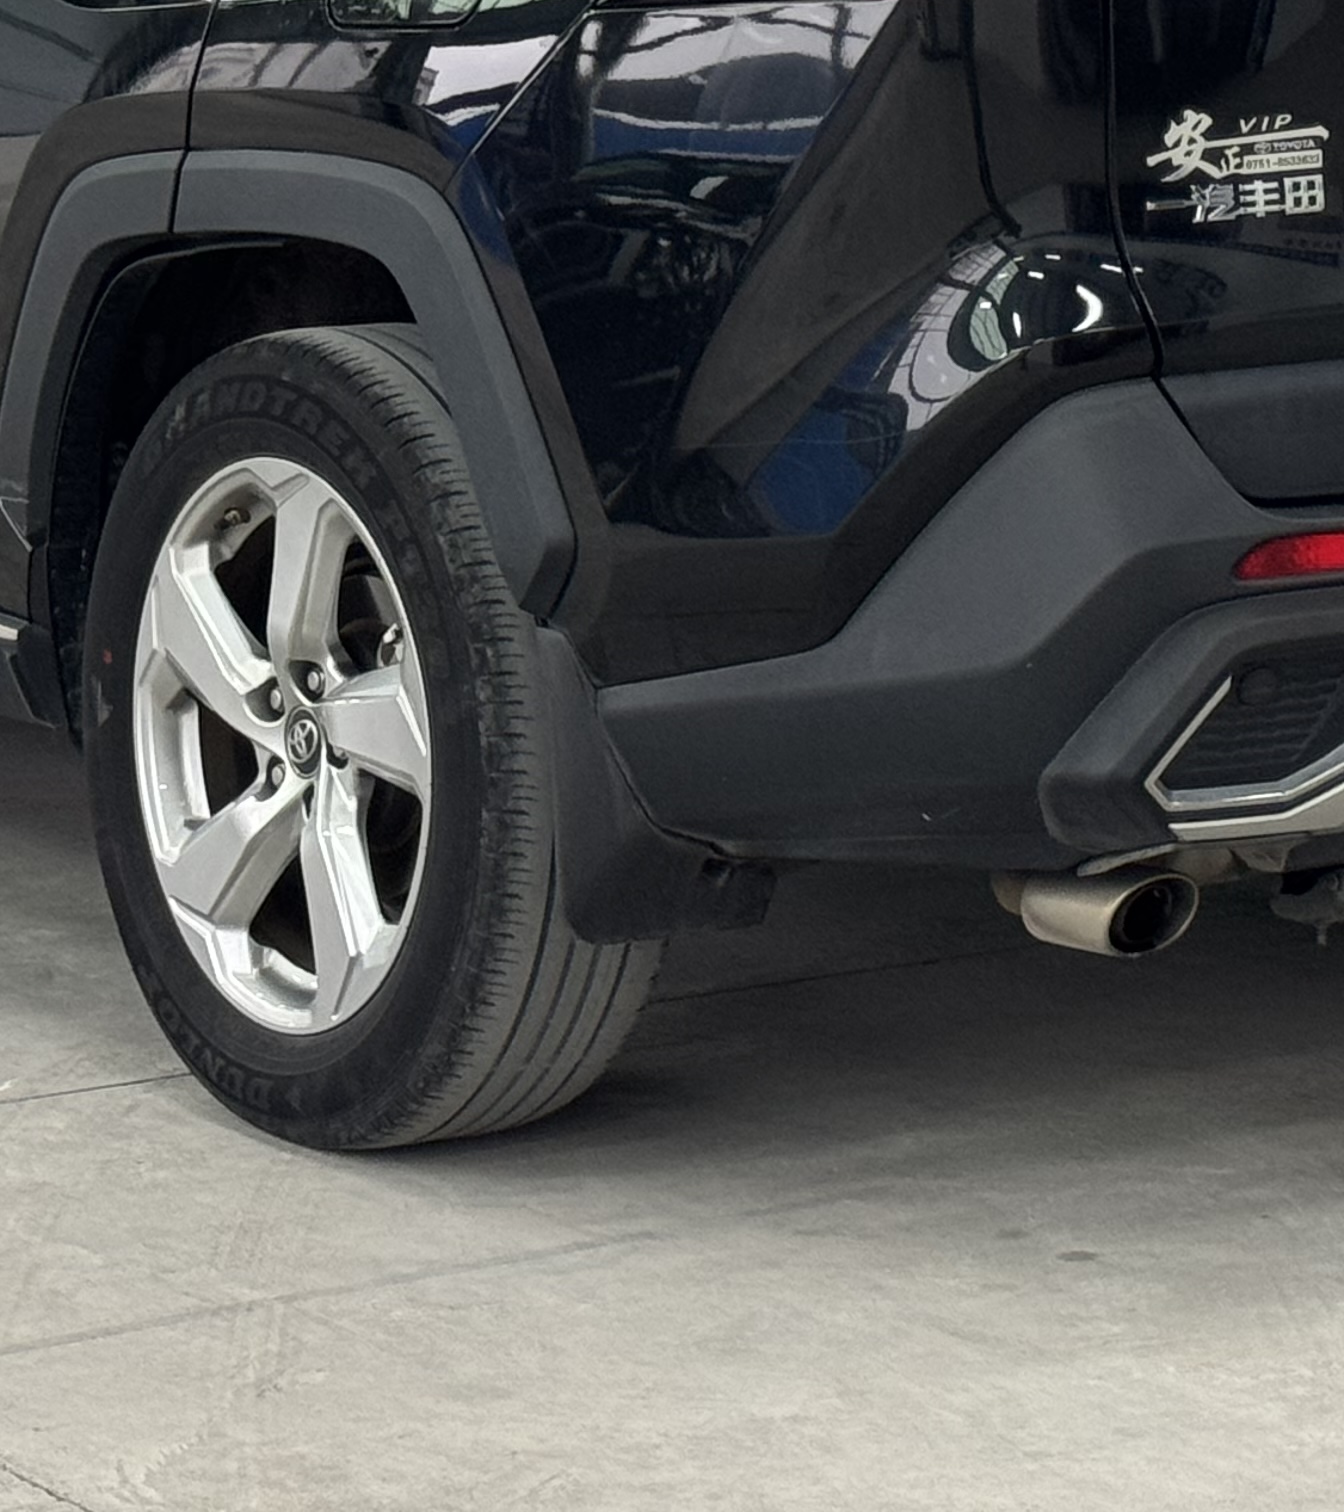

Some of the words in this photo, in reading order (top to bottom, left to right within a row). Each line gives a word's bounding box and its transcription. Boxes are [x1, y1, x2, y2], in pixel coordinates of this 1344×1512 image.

[1239, 114, 1293, 134] VIP
[1272, 138, 1316, 154] TOYOTA
[1146, 174, 1325, 224] 一汽丰田
